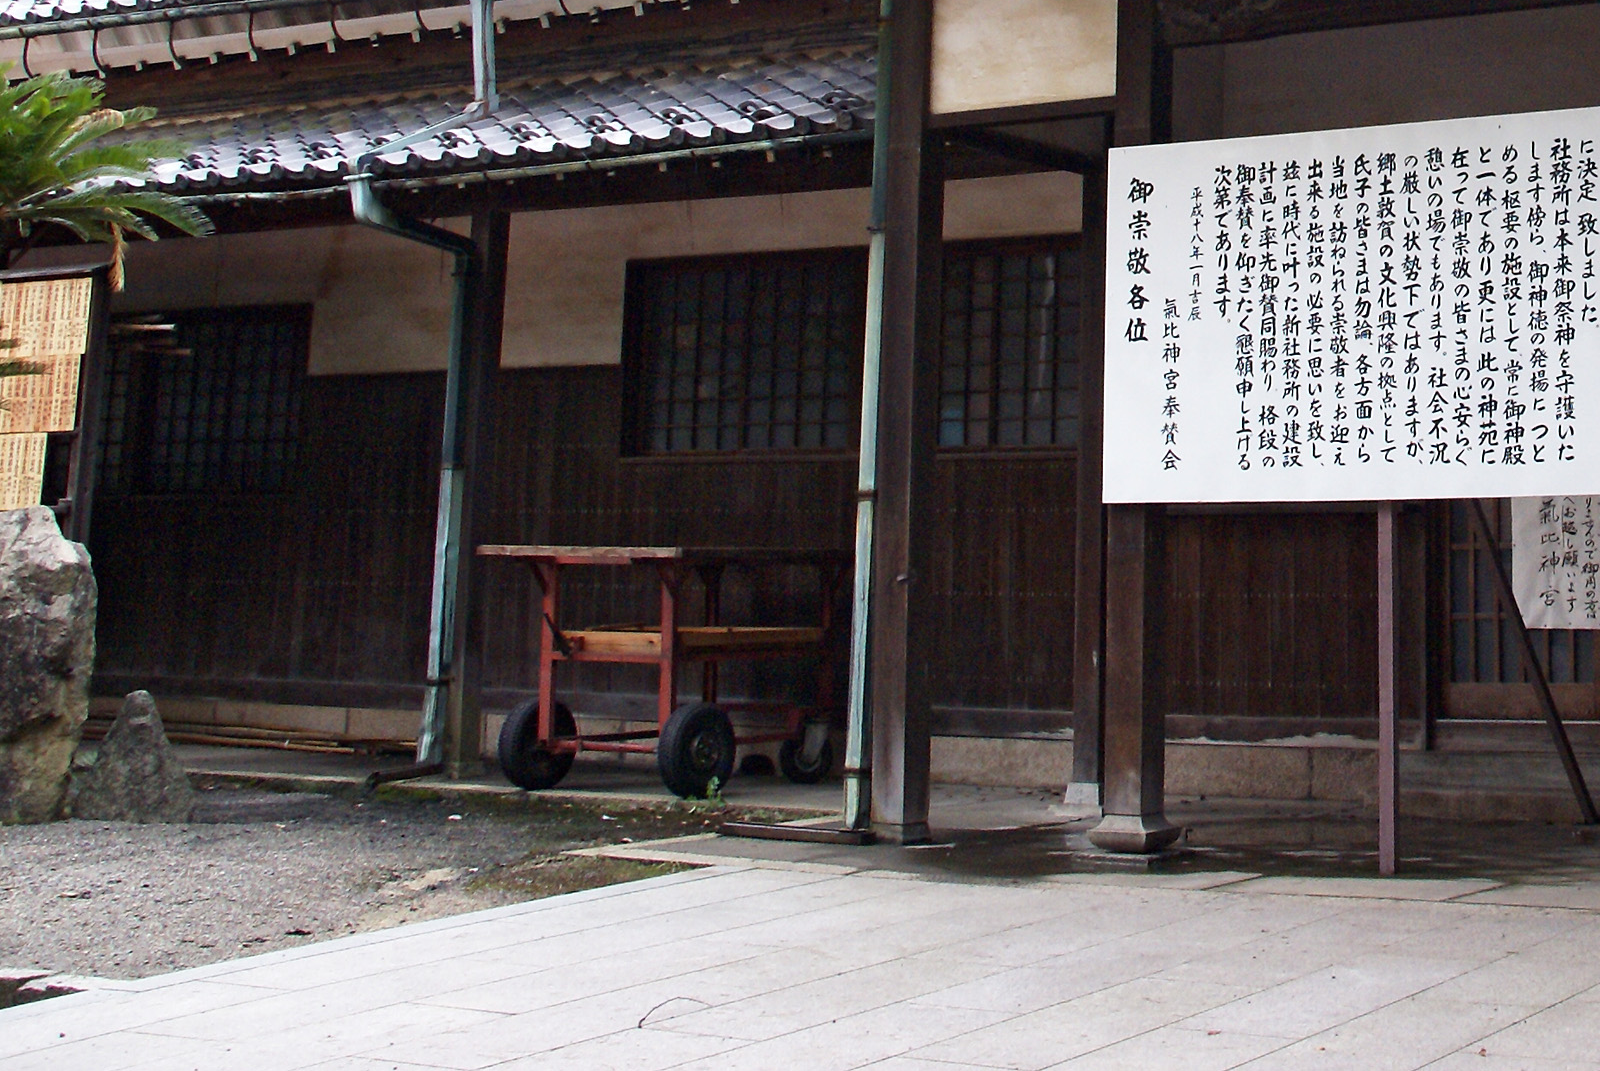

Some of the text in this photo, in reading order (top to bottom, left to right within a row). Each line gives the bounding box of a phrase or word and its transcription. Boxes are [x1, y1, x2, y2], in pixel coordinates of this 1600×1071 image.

[1124, 177, 1155, 343] 御崇敬各位
[1161, 298, 1182, 471] 氣比神宮奉賛会
[1187, 186, 1204, 321] 平成十八年一月吉辰
[1213, 164, 1234, 324] 次第であります。
[1234, 163, 1257, 471] 御奉賛を仰ぎたく懇願申し上げる
[1306, 158, 1326, 467] 出来る施設の必要に思いを致し、
[1328, 154, 1350, 466] 当地を訪ねられる崇敬者をお迎え
[1352, 153, 1375, 463] 氏子の皆さまは勿論、各方面から
[1376, 152, 1399, 463] 郷土敦賀の文化興隆の拠点として
[1399, 155, 1424, 465] の厳しい状勢下ではありますが、
[1423, 146, 1451, 465] 憩いの場でもあります。社会不況
[1450, 146, 1473, 466] 在って御崇敬の皆さまの心安らぐ
[1475, 146, 1500, 465] と一体であり更には此の神苑に
[1526, 140, 1550, 463] します傍ら、御神徳の発揚につと
[1549, 137, 1576, 461] 社務所は本来御祭神を守護いた
[1576, 139, 1600, 329] に決定致しました。
[1538, 498, 1561, 607] 氣比神宮
